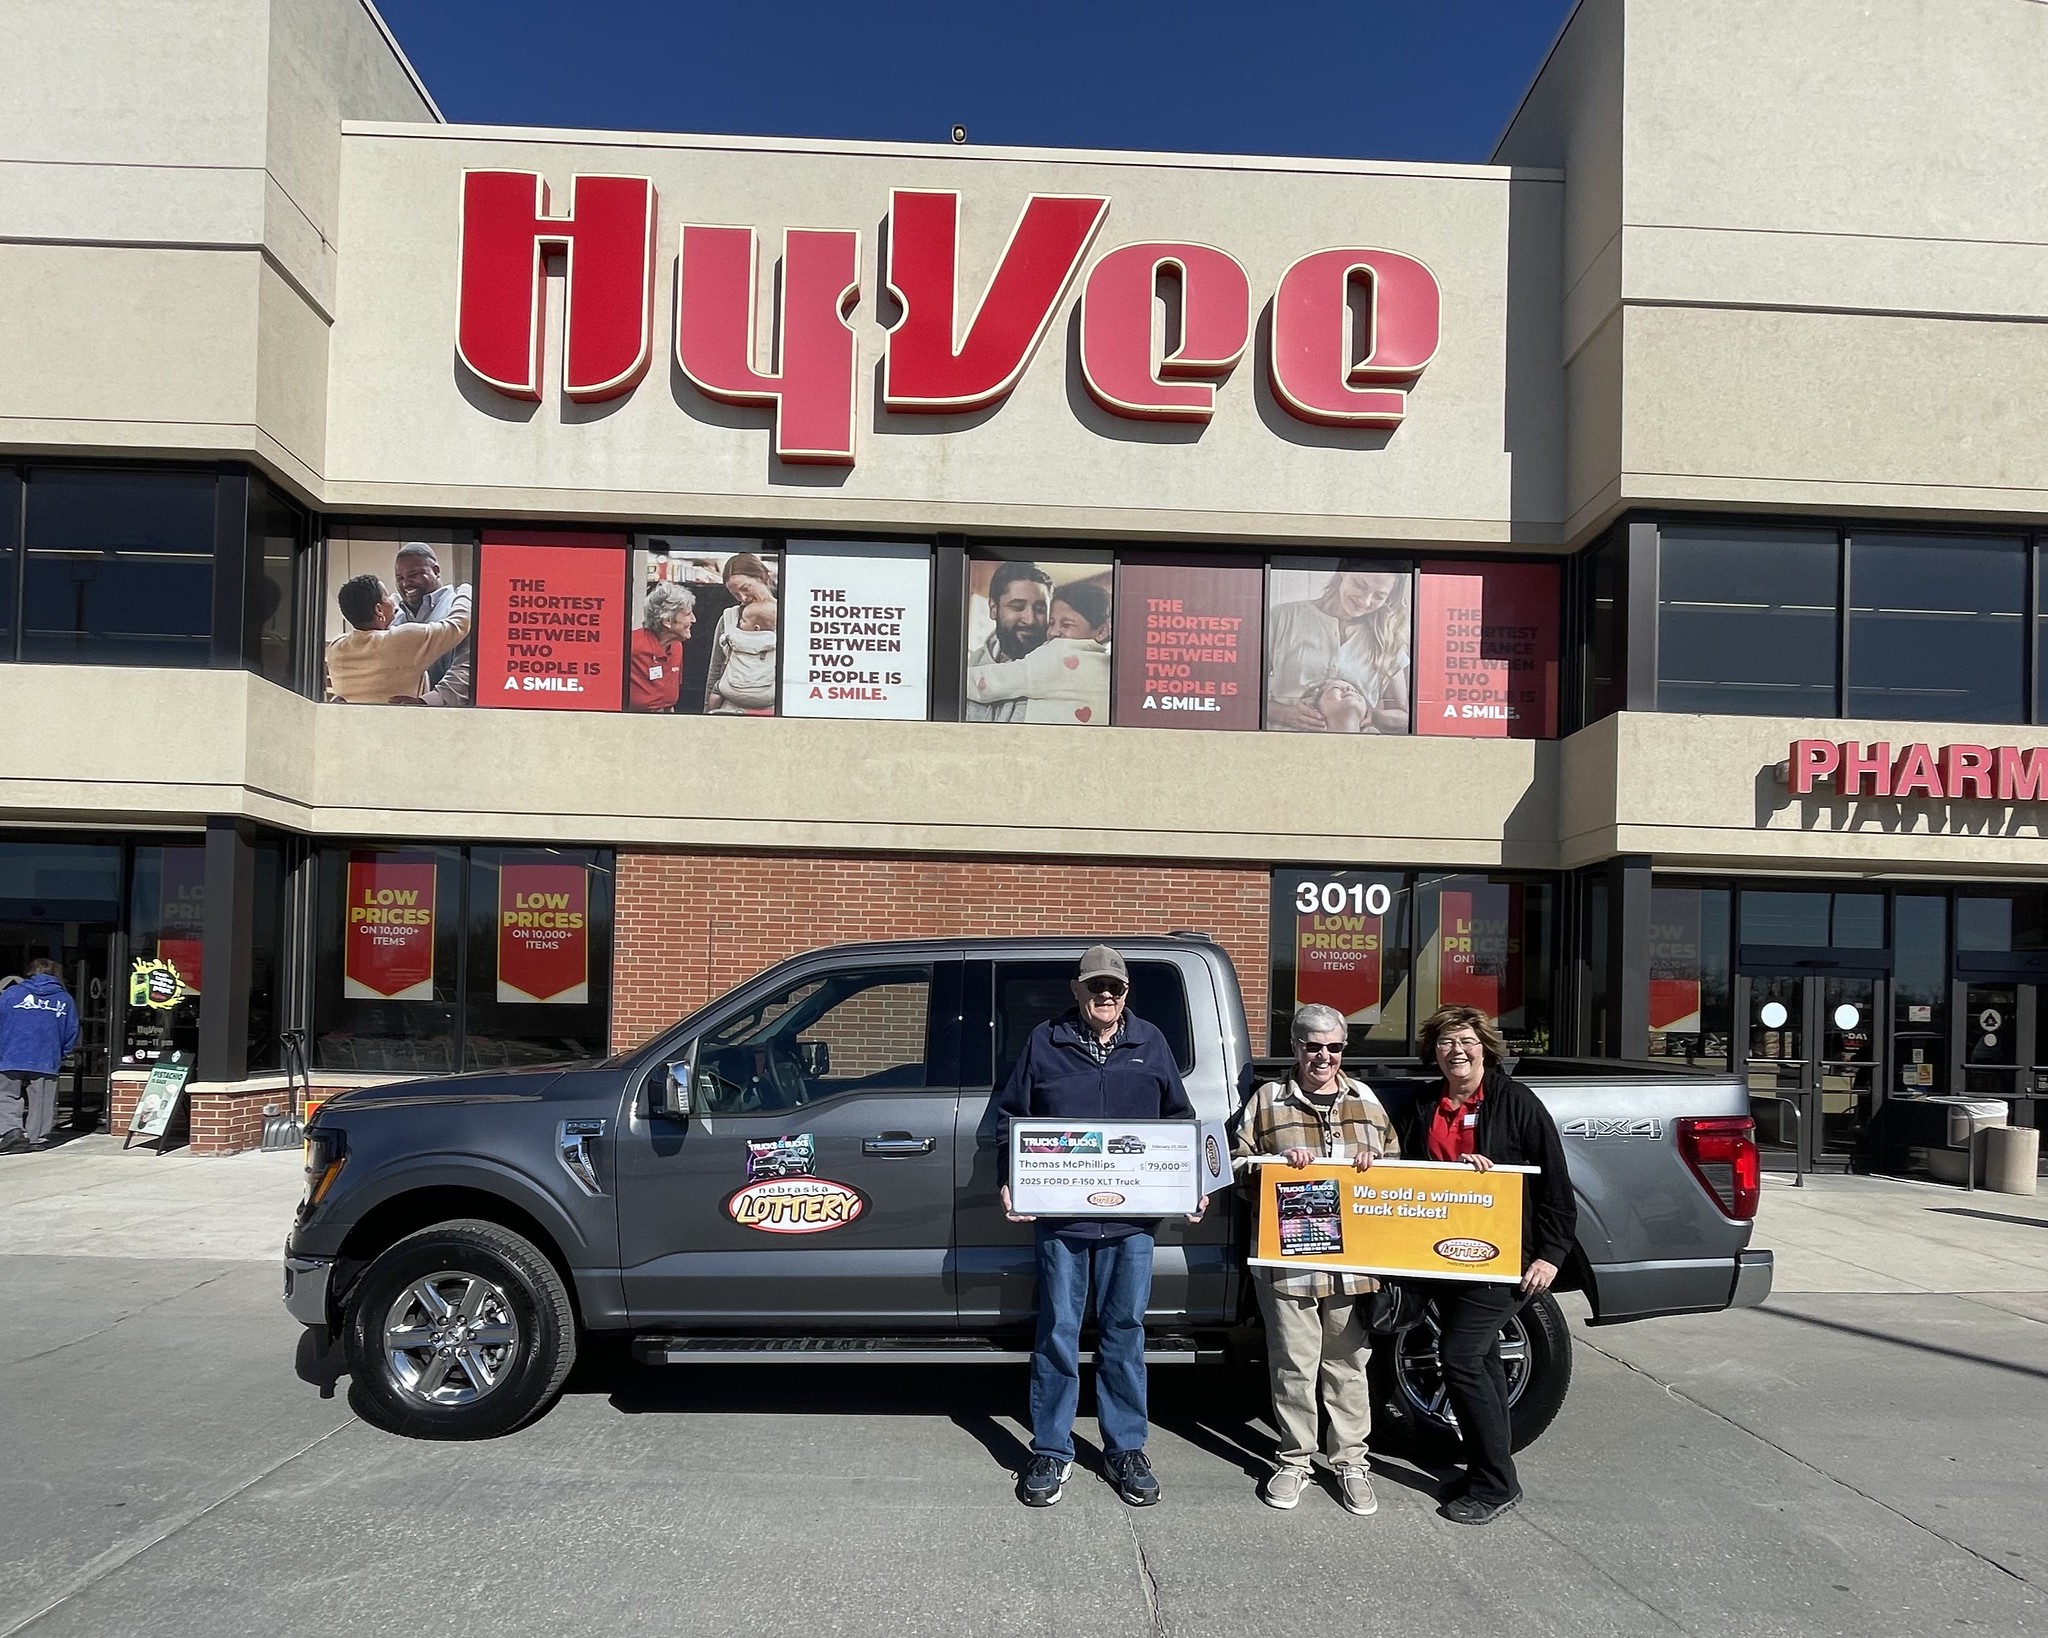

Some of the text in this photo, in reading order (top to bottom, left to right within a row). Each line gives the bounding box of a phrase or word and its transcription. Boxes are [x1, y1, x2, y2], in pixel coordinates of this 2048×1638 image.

[455, 168, 1443, 460] HyVee
[509, 579, 545, 592] THE
[509, 595, 605, 610] SHORTEST
[810, 589, 846, 602] THE
[810, 605, 906, 620] SHORTEST
[1147, 598, 1183, 613] THE
[508, 611, 600, 627] DISTANCE
[1446, 608, 1482, 621] THE
[810, 621, 900, 636] DISTANCE
[1146, 615, 1243, 631] SHORTEST
[508, 628, 600, 643] BETWEEN
[1146, 631, 1237, 647] DISTANCE
[1446, 624, 1538, 639] SHORTEST
[507, 644, 553, 658] TWO
[810, 637, 901, 652] BETWEEN
[1446, 640, 1535, 655] DISTANCE
[808, 654, 854, 667] TWO
[1146, 647, 1237, 663] BETWEEN
[507, 660, 601, 676] PEOPLE IS
[1145, 663, 1191, 678] TWO
[1446, 656, 1535, 671] BETWEEN
[503, 676, 584, 692] A SMILE.
[808, 670, 902, 685] PEOPLE IS
[1445, 673, 1490, 686] TWO
[809, 686, 888, 701] A SMILE.
[1144, 679, 1238, 696] PEOPLE IS
[1445, 688, 1515, 703] PEOPLE
[1142, 695, 1221, 712] A SMILE.
[1443, 704, 1520, 720] A SMILE.
[1788, 739, 2048, 800] PHARM
[365, 889, 418, 906] LOW
[516, 893, 570, 909] LOW
[1296, 882, 1391, 915] 3010
[351, 907, 430, 925] PRICES
[503, 911, 584, 928] PRICES
[1313, 914, 1366, 931] LOW
[360, 925, 419, 936] ON 10,000+
[1456, 919, 1506, 934] LOW
[373, 937, 406, 946] ITEMS
[512, 930, 573, 939] ON 10,000+
[1301, 933, 1378, 950] PRICES
[526, 941, 559, 950] ITEMS
[1444, 936, 1520, 954] PRICES
[1310, 951, 1368, 961] ON 10,000+
[1453, 954, 1470, 963] ON
[1323, 962, 1355, 971] ITEMS
[153, 1071, 184, 1081] PISTACHIO
[1019, 1160, 1116, 1170] Thomas McPhillips
[1147, 1162, 1180, 1171] 79,000
[758, 1185, 829, 1194] nebraska
[1072, 1178, 1095, 1186] F-150
[1097, 1178, 1112, 1186] XLT
[1115, 1178, 1141, 1186] Truck
[1353, 1185, 1493, 1207] We sold a winning
[736, 1193, 859, 1225] LOTTERY
[1352, 1202, 1448, 1219] truck ticket!
[1440, 1244, 1494, 1259] LOTTERY
